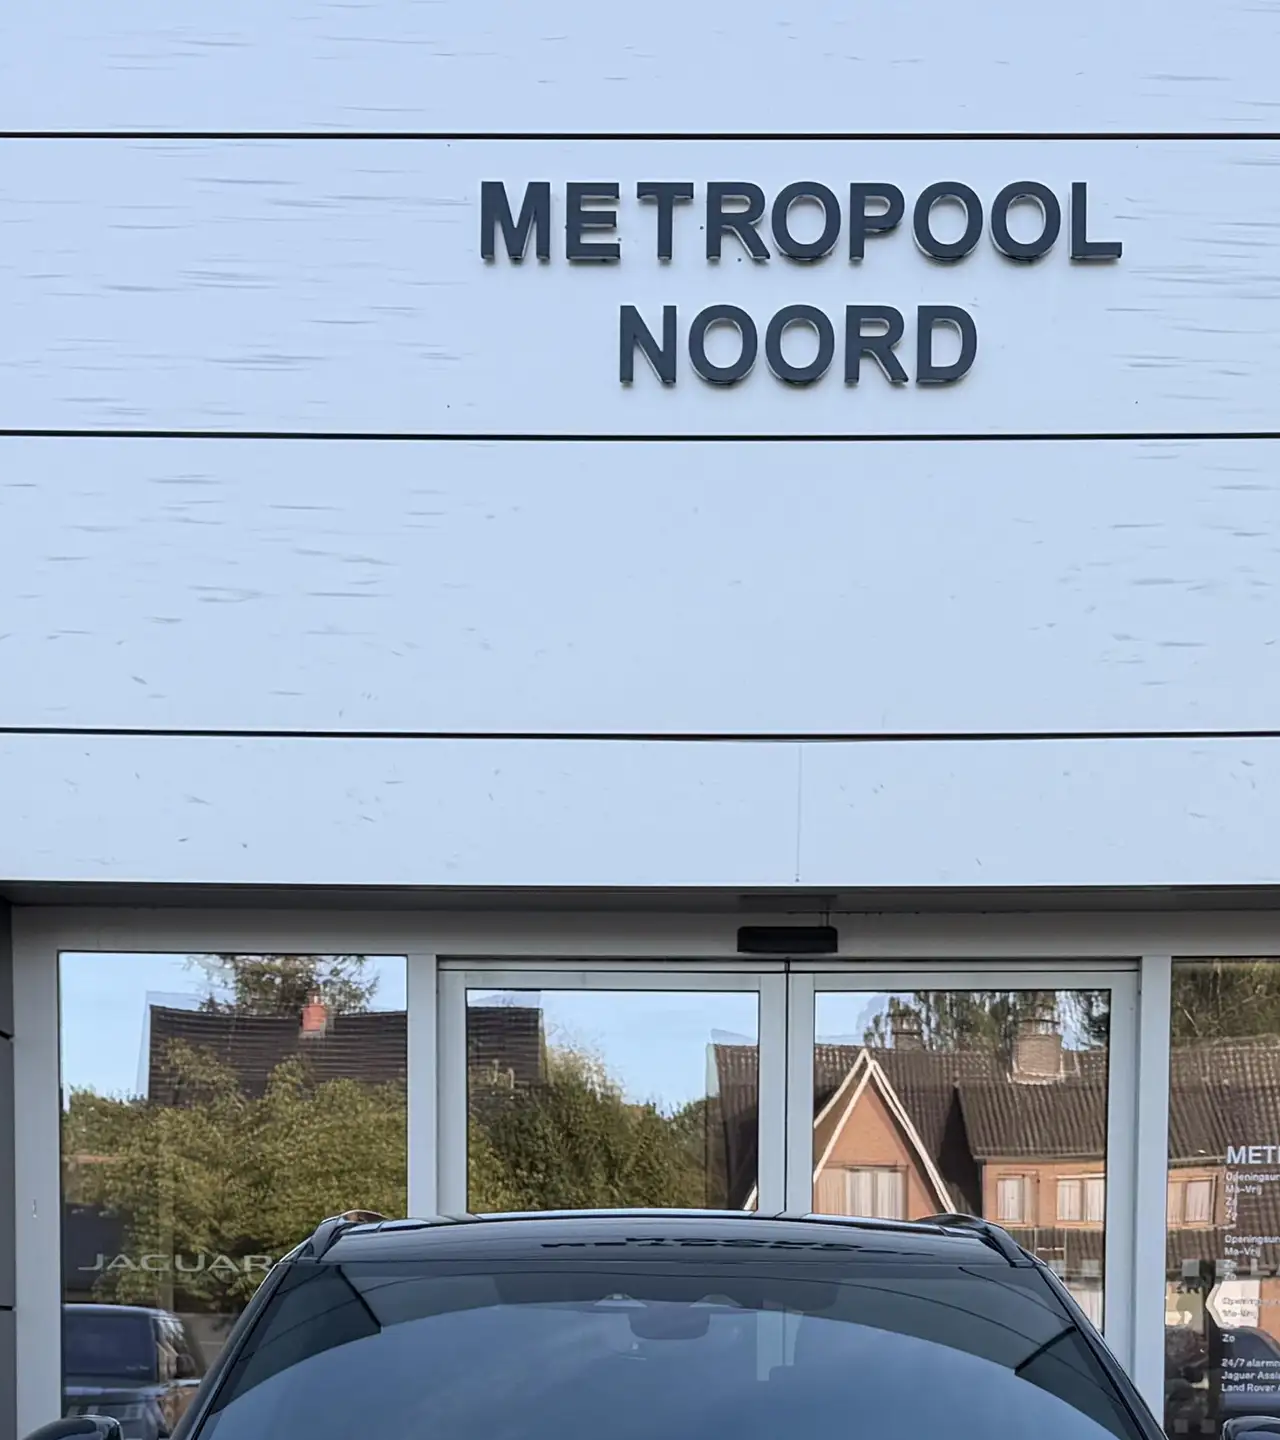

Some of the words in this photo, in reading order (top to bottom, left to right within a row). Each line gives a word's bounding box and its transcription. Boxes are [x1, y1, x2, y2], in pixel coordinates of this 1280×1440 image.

[481, 181, 1123, 263] METROPOOL
[619, 304, 978, 386] NOORD
[78, 1253, 274, 1272] JAGUAR
[1221, 1357, 1245, 1368] 24/7
[1221, 1371, 1256, 1381] Jaguar
[1221, 1383, 1245, 1392] Land
[1247, 1383, 1275, 1392] Rover
